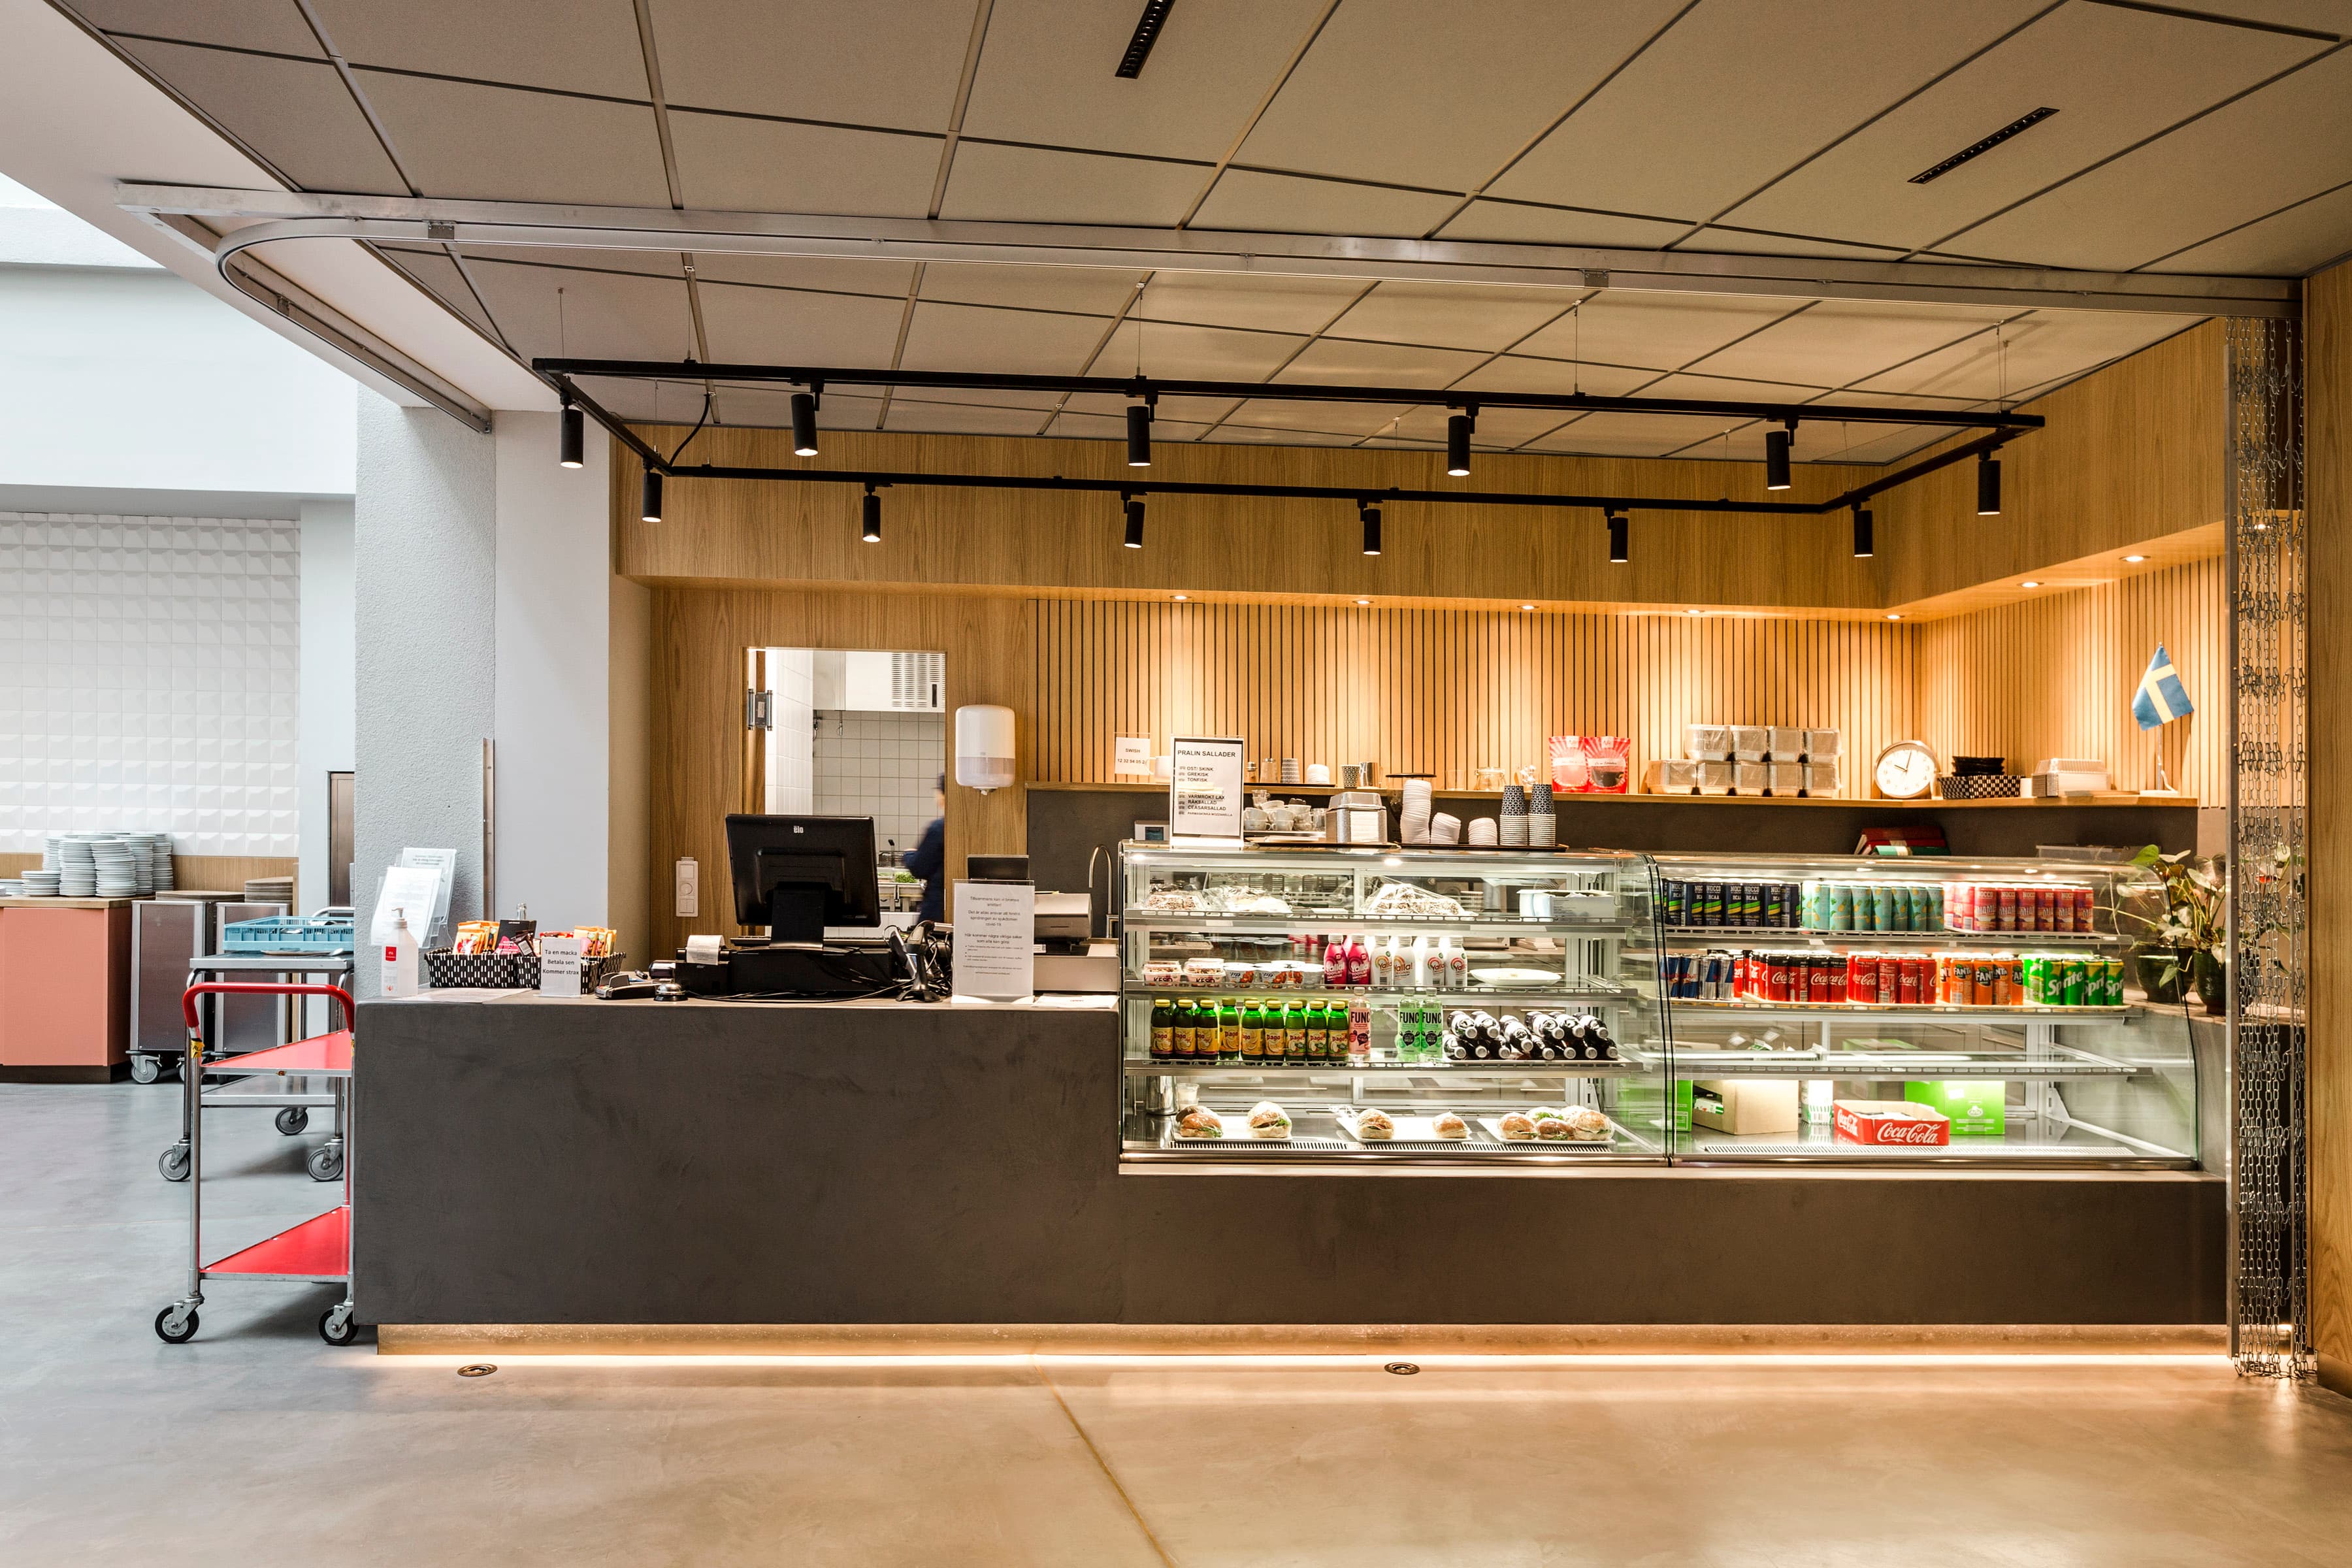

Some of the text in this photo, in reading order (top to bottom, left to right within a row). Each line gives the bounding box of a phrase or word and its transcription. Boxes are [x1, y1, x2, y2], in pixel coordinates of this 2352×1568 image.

[1399, 1011, 1419, 1023] FUNC
[1422, 1012, 1442, 1024] FUNC
[1877, 1122, 1942, 1144] Coca-Cola
